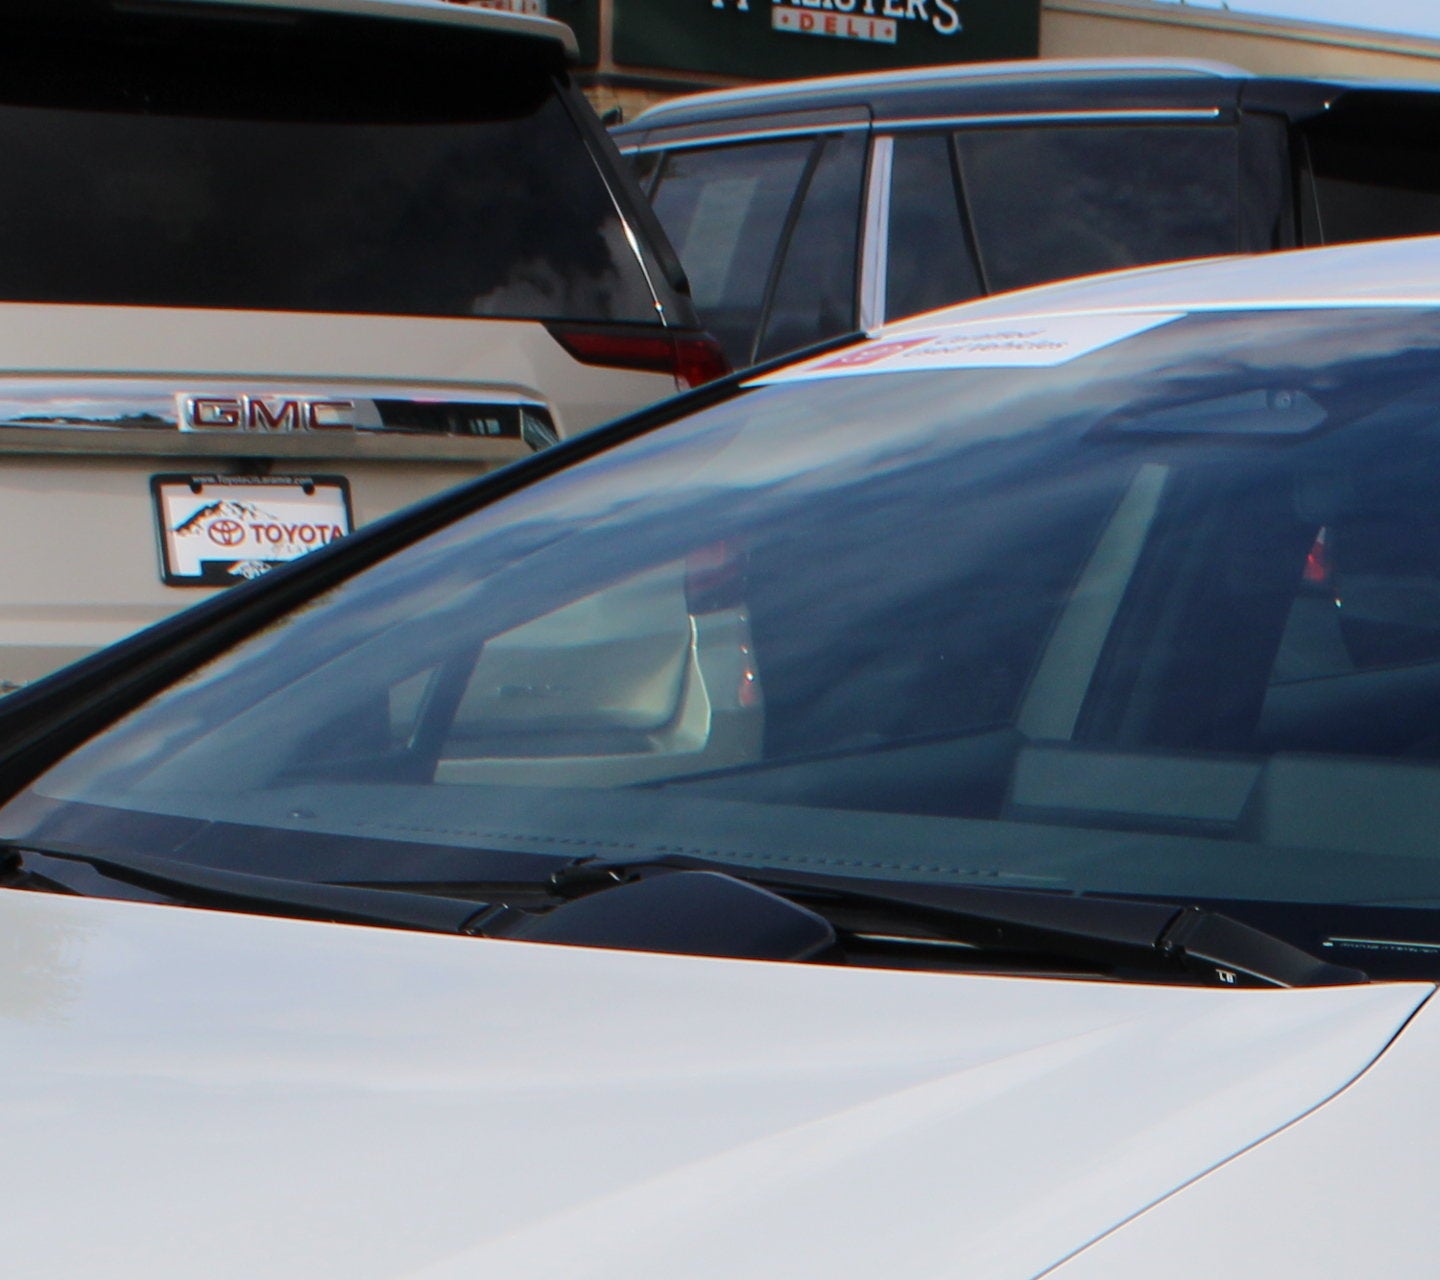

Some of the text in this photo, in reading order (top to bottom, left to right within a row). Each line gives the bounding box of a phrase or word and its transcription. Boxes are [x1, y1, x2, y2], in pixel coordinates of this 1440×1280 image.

[799, 13, 875, 37] DELI
[187, 397, 355, 431] GMC
[250, 523, 346, 544] TOYOTA
